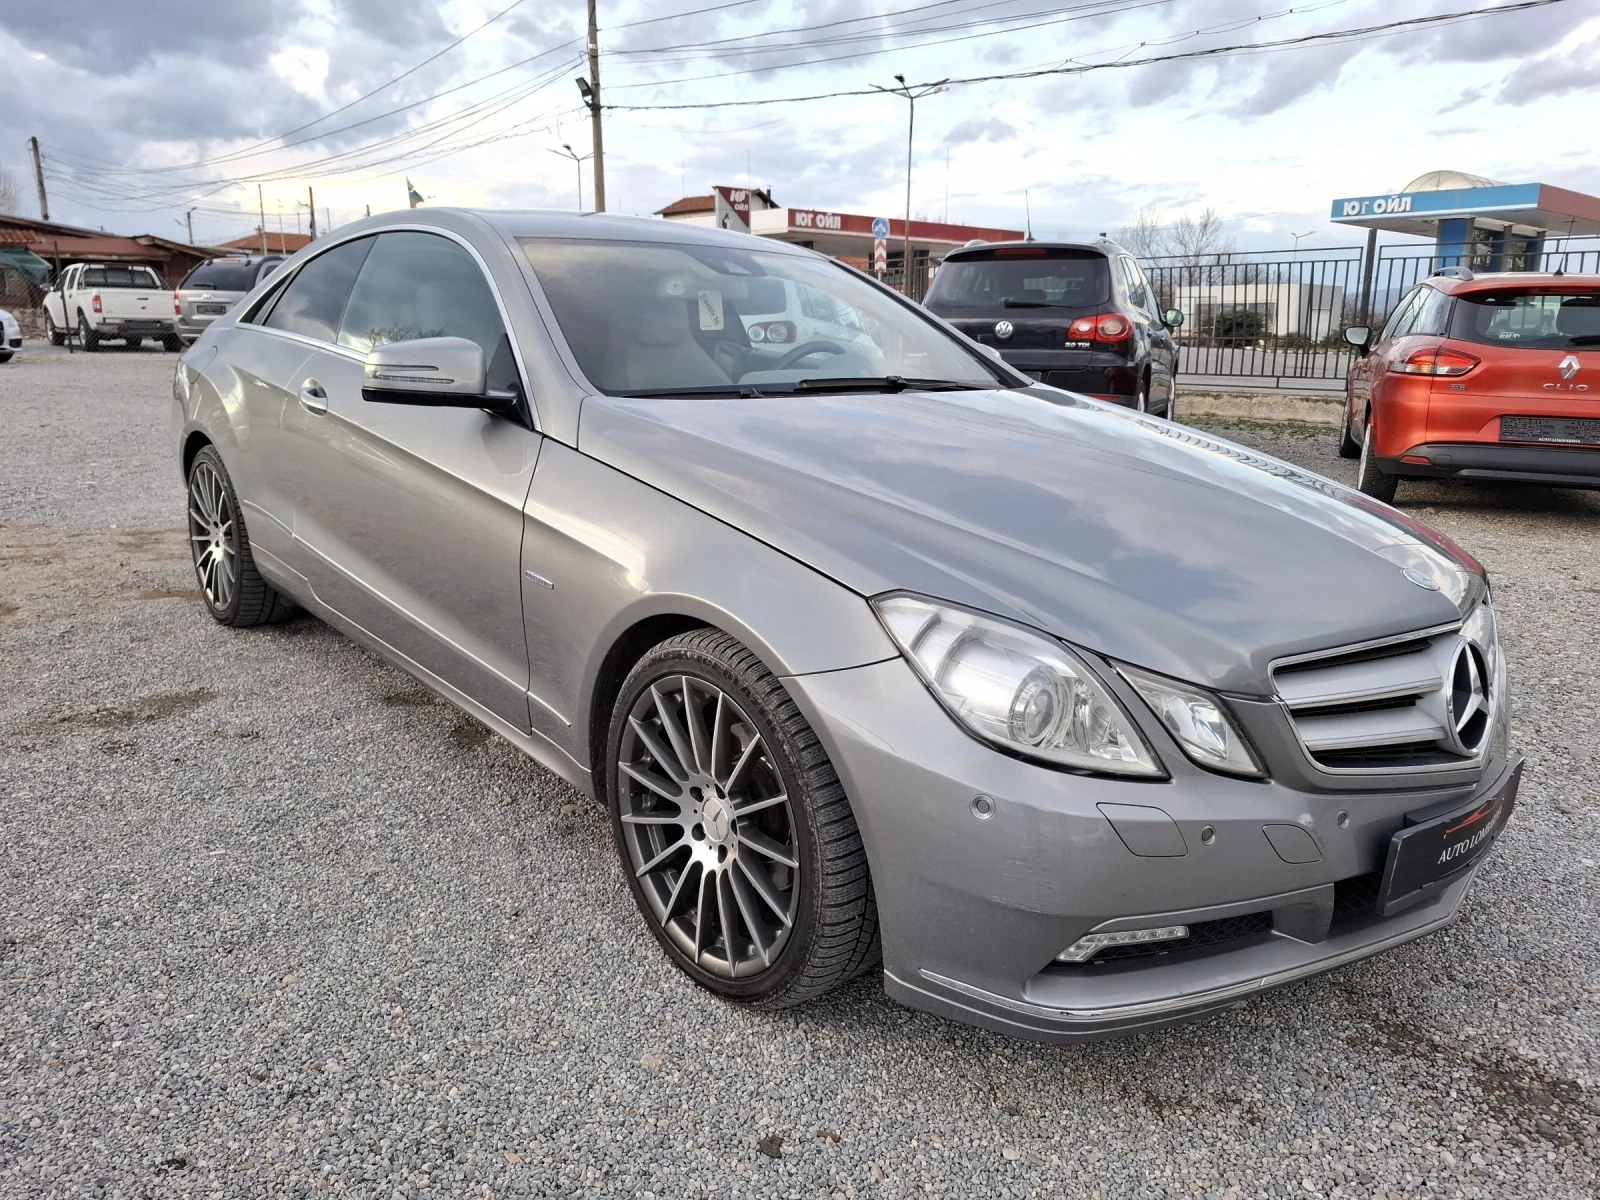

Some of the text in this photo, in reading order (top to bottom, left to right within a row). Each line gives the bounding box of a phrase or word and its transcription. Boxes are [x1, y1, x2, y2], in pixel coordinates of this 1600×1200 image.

[734, 203, 749, 211] ОЙЛ
[1343, 195, 1412, 216] ЮГ ОЙЛ
[796, 212, 841, 229] ЮГ ОЙЛ
[1543, 383, 1589, 392] CLIO
[1438, 840, 1469, 864] AUTO
